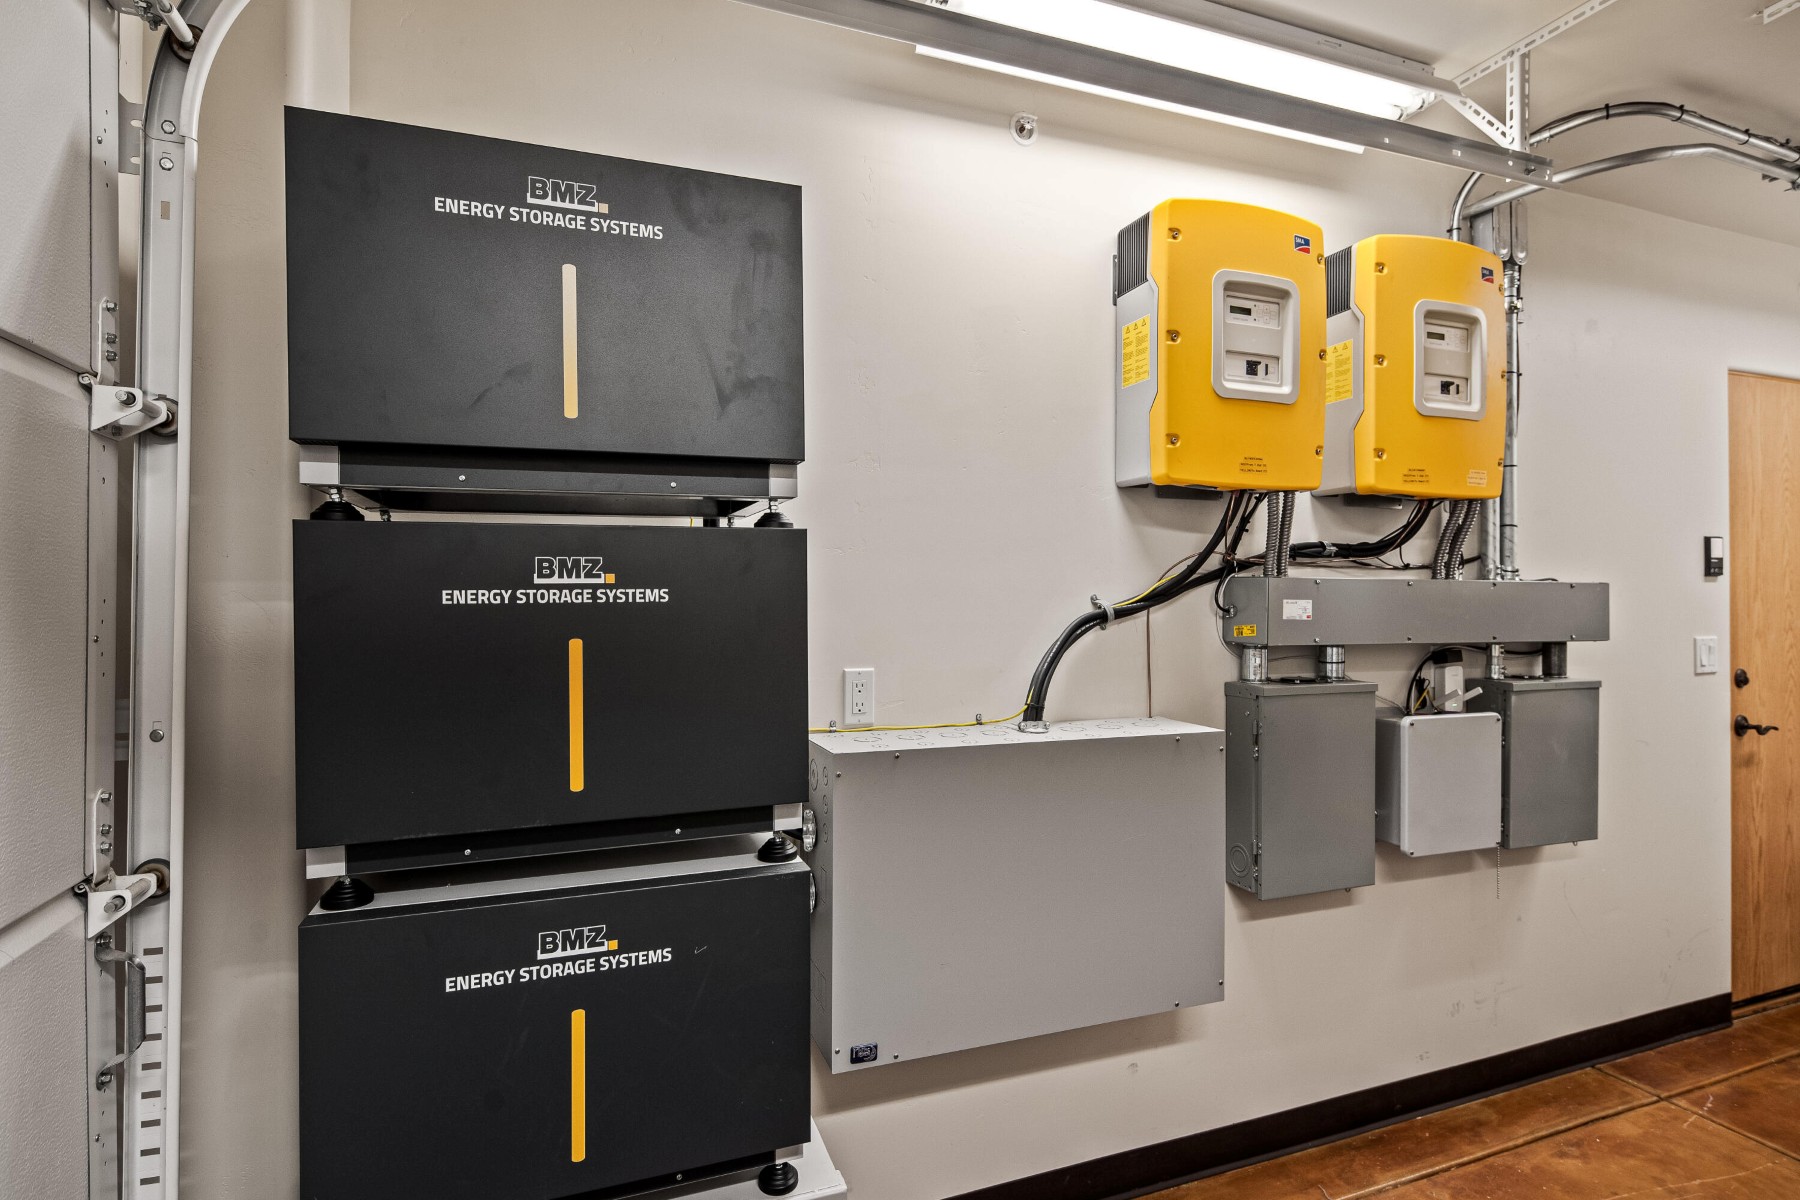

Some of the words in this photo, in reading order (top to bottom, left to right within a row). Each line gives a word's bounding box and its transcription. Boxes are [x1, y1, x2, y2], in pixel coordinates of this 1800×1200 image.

[434, 196, 505, 220] ENERGY
[509, 206, 586, 231] STORAGE
[590, 217, 664, 240] SYSTEMS
[442, 589, 512, 605] ENERGY
[516, 588, 593, 604] STORAGE
[596, 588, 669, 603] SYSTEMS
[445, 968, 515, 993] ENERGY
[519, 958, 596, 983] STORAGE
[599, 947, 672, 972] SYSTEMS
